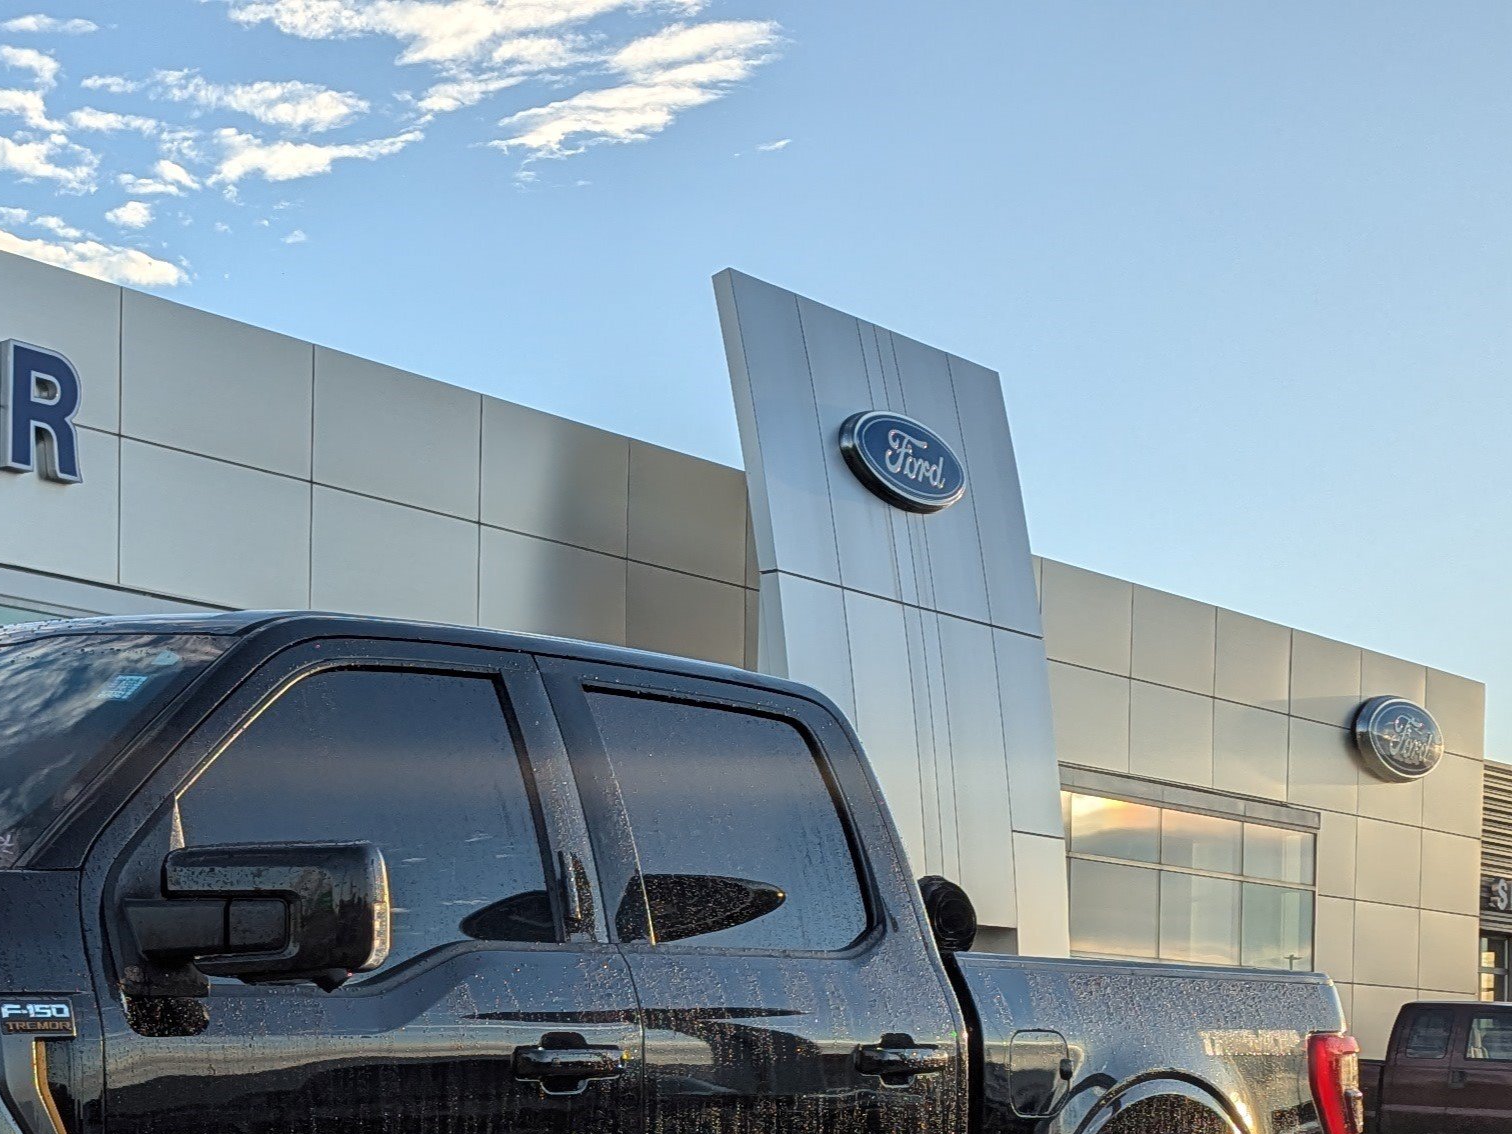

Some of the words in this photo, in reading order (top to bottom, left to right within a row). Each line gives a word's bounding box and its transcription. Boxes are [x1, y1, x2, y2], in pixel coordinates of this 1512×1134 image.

[885, 429, 946, 489] Ford
[1389, 714, 1434, 763] Ford
[0, 1003, 71, 1019] F-150
[5, 1020, 73, 1031] TREMOR
